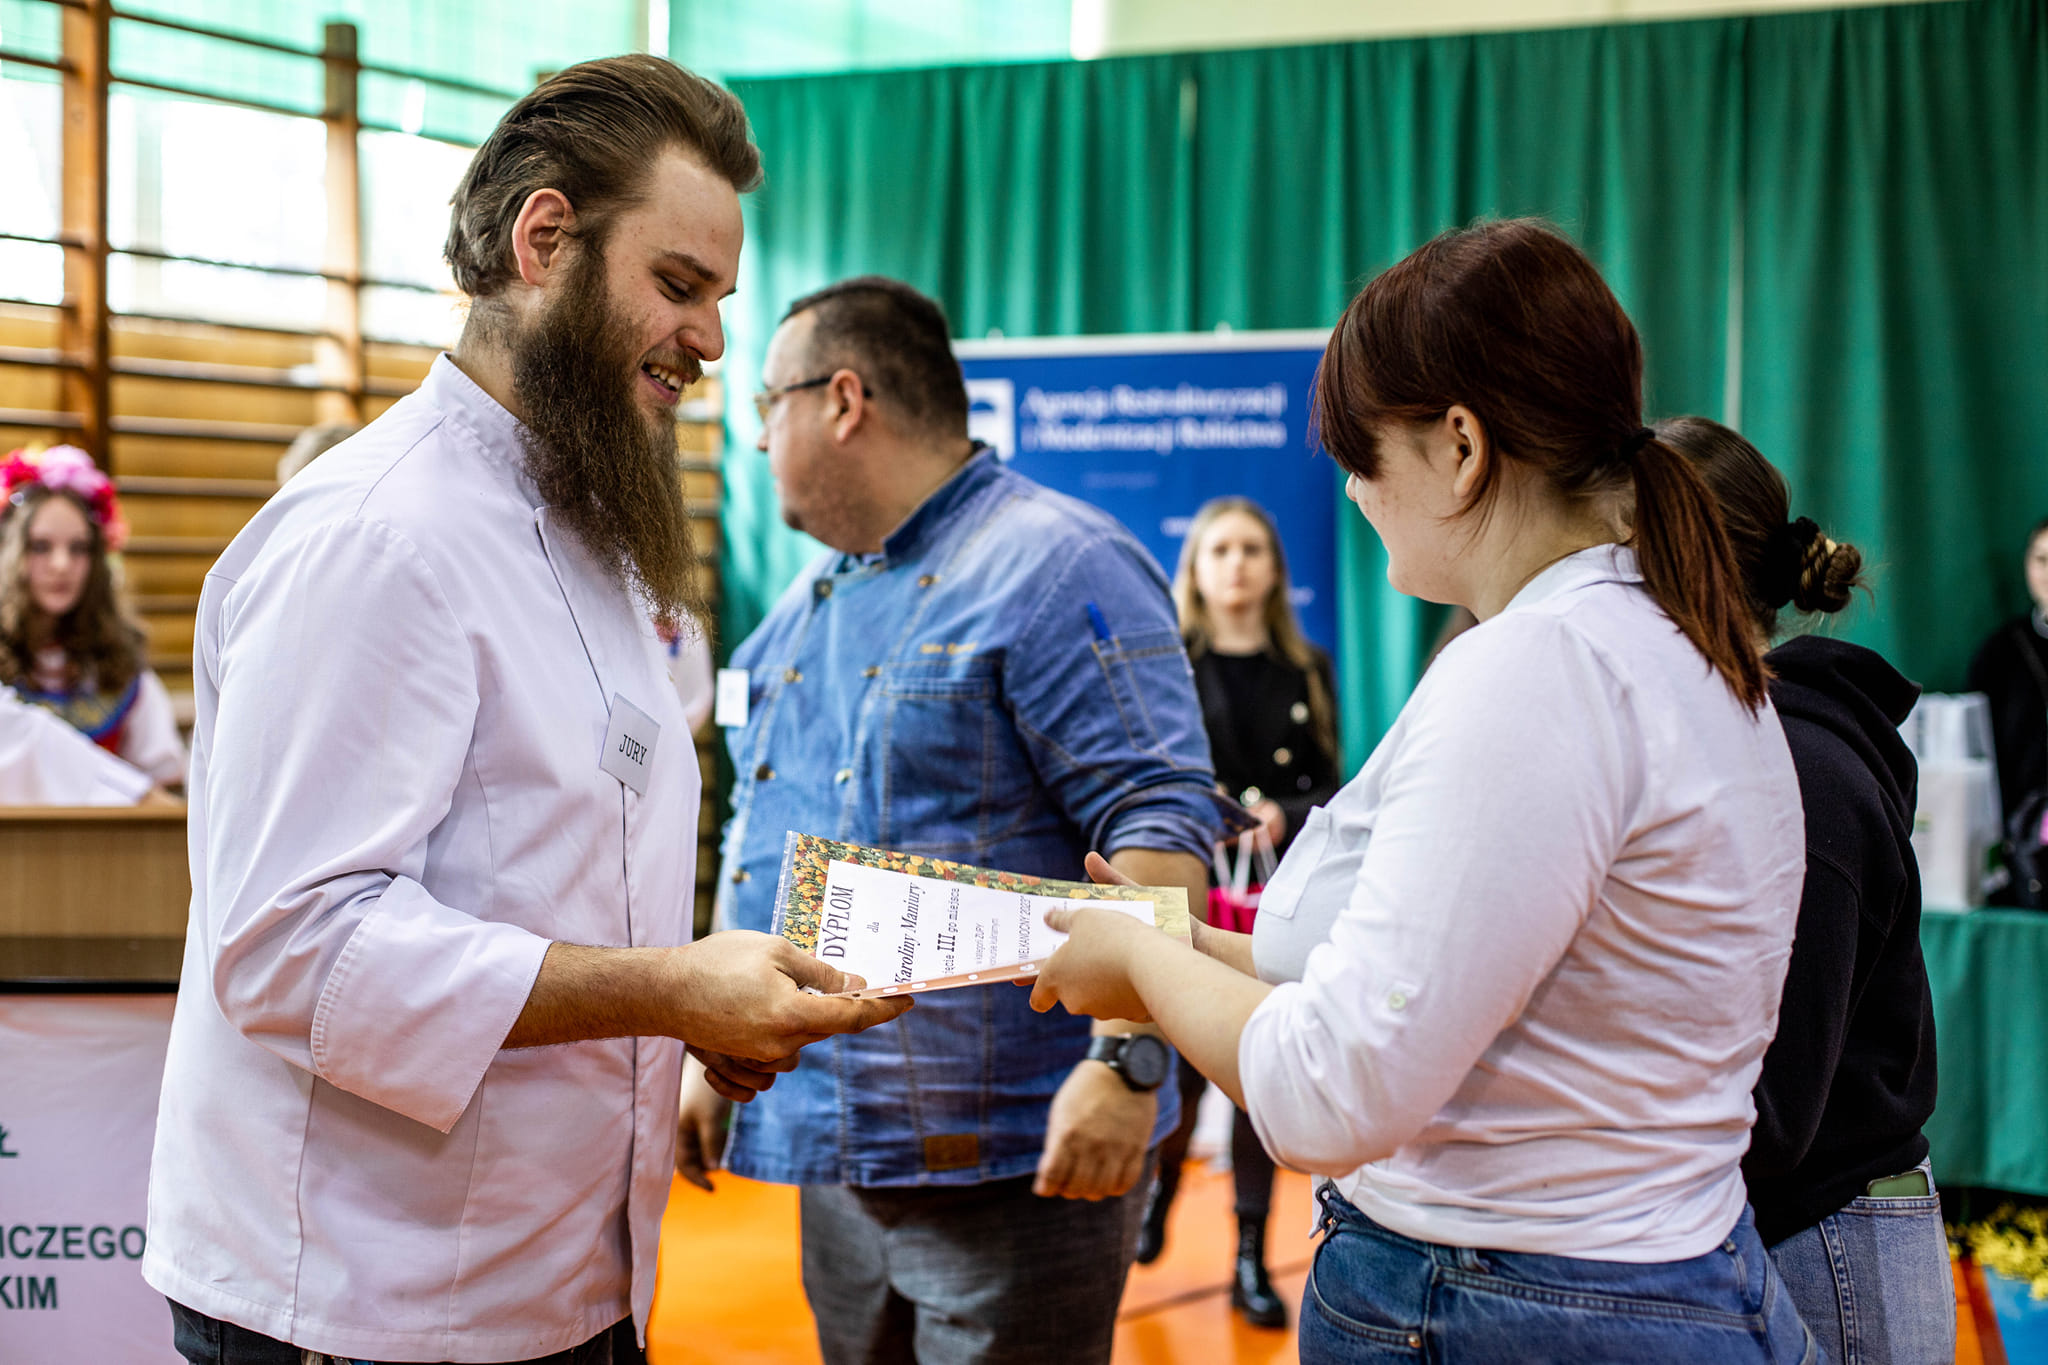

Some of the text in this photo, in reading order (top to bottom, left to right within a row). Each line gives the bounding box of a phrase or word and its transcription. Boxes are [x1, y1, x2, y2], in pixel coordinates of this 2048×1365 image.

[618, 734, 648, 766] JURY
[821, 885, 855, 958] DYPLOM
[866, 921, 880, 933] dla
[937, 933, 956, 952] III
[948, 921, 959, 933] go
[894, 933, 921, 984] Karoliny
